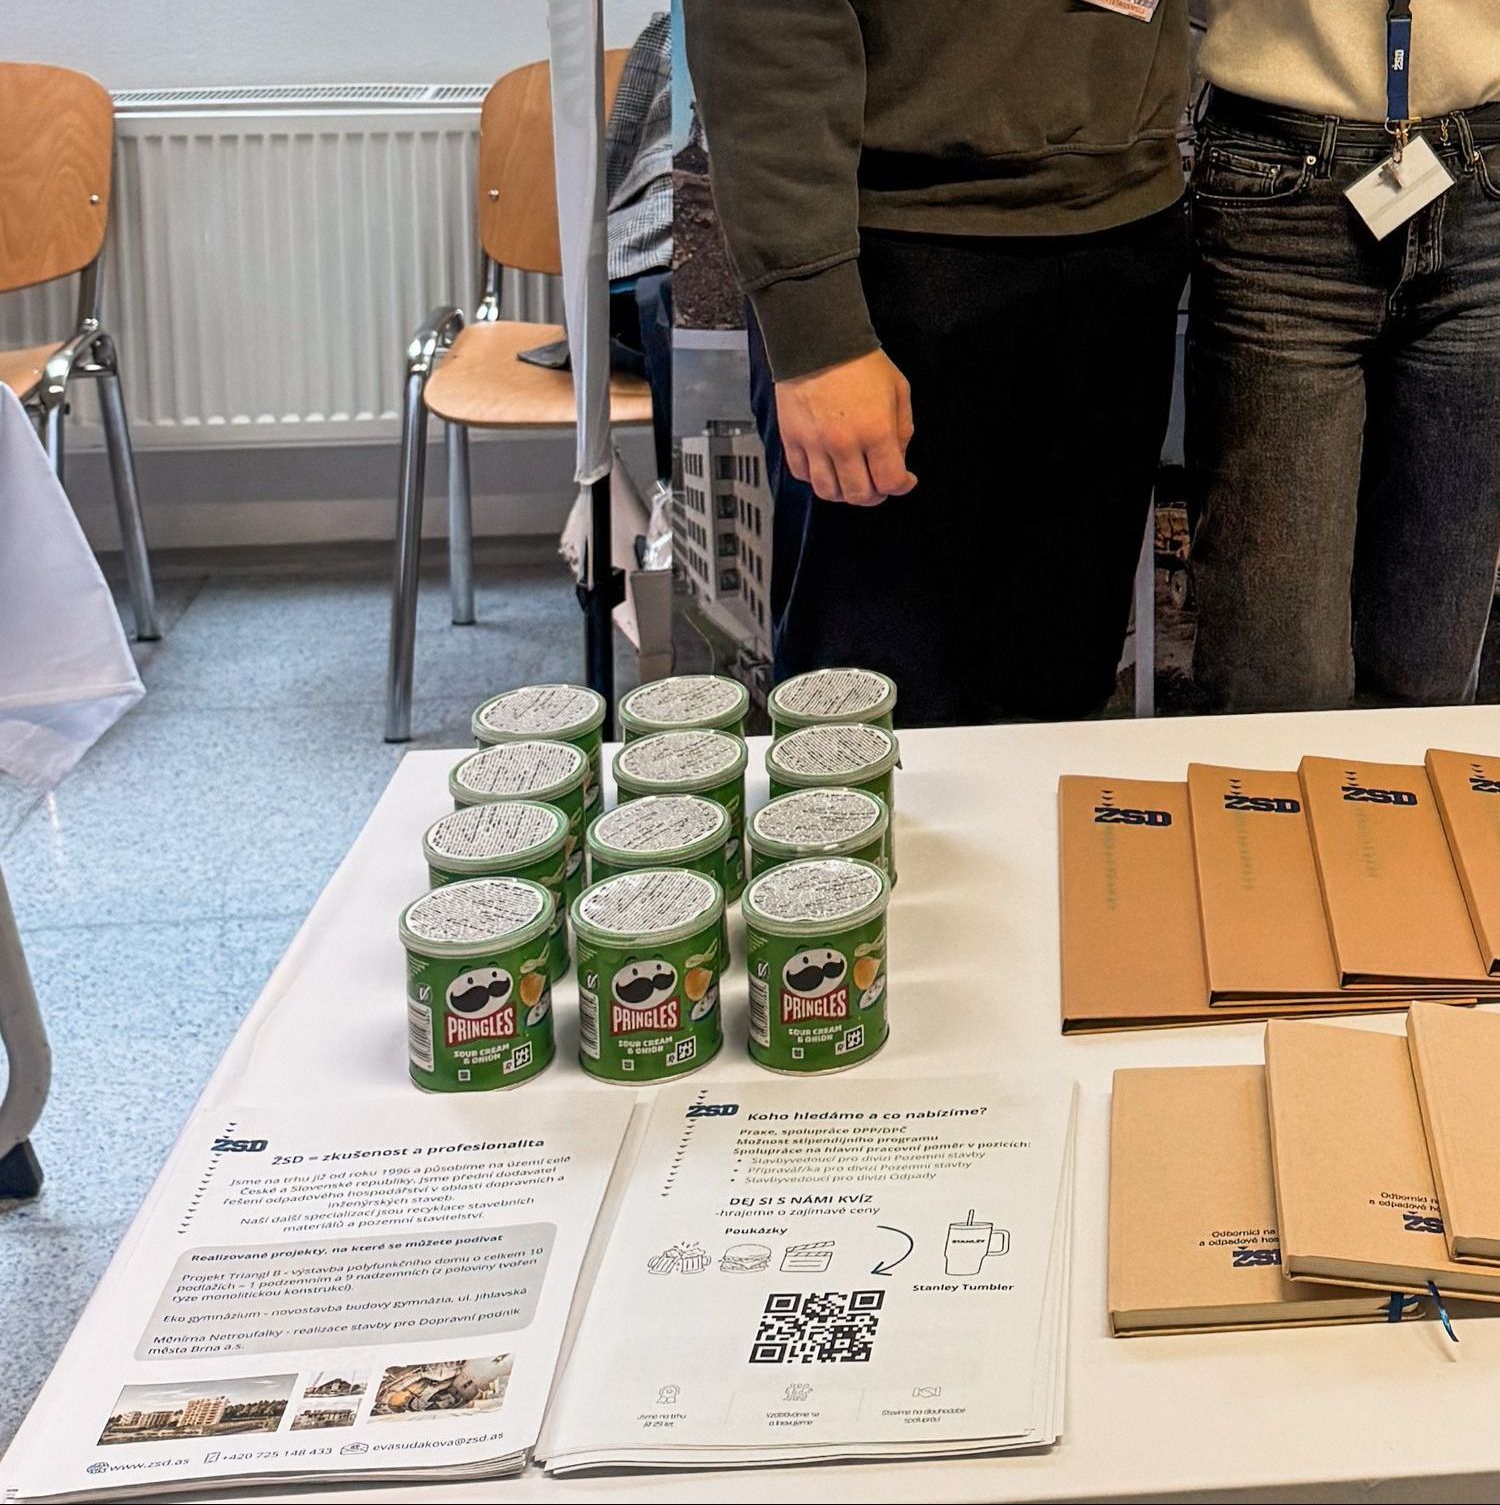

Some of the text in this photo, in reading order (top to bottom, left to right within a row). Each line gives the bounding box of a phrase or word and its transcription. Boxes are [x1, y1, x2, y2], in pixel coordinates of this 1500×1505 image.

[784, 989, 847, 1021] PRINGLES
[447, 1008, 513, 1043] PRINGLES
[613, 1001, 677, 1033] PRINGLES
[748, 1112, 788, 1121] Koho
[794, 1110, 864, 1120] hledáme
[905, 1107, 988, 1119] nabízíme?
[322, 1148, 408, 1162] zkušenost
[427, 1139, 545, 1156] profesionalita
[729, 1197, 755, 1206] DEJ
[759, 1197, 773, 1205] SI
[790, 1195, 833, 1205] NÁMI
[838, 1194, 873, 1203] KVÍZ
[725, 1227, 788, 1236] Poukázky
[191, 1251, 268, 1262] Realizované
[270, 1248, 328, 1261] projekty,
[351, 1243, 385, 1252] které
[405, 1238, 453, 1248] můžete
[455, 1235, 503, 1245] podívat
[913, 1283, 1015, 1292] Stanley Tumbler
